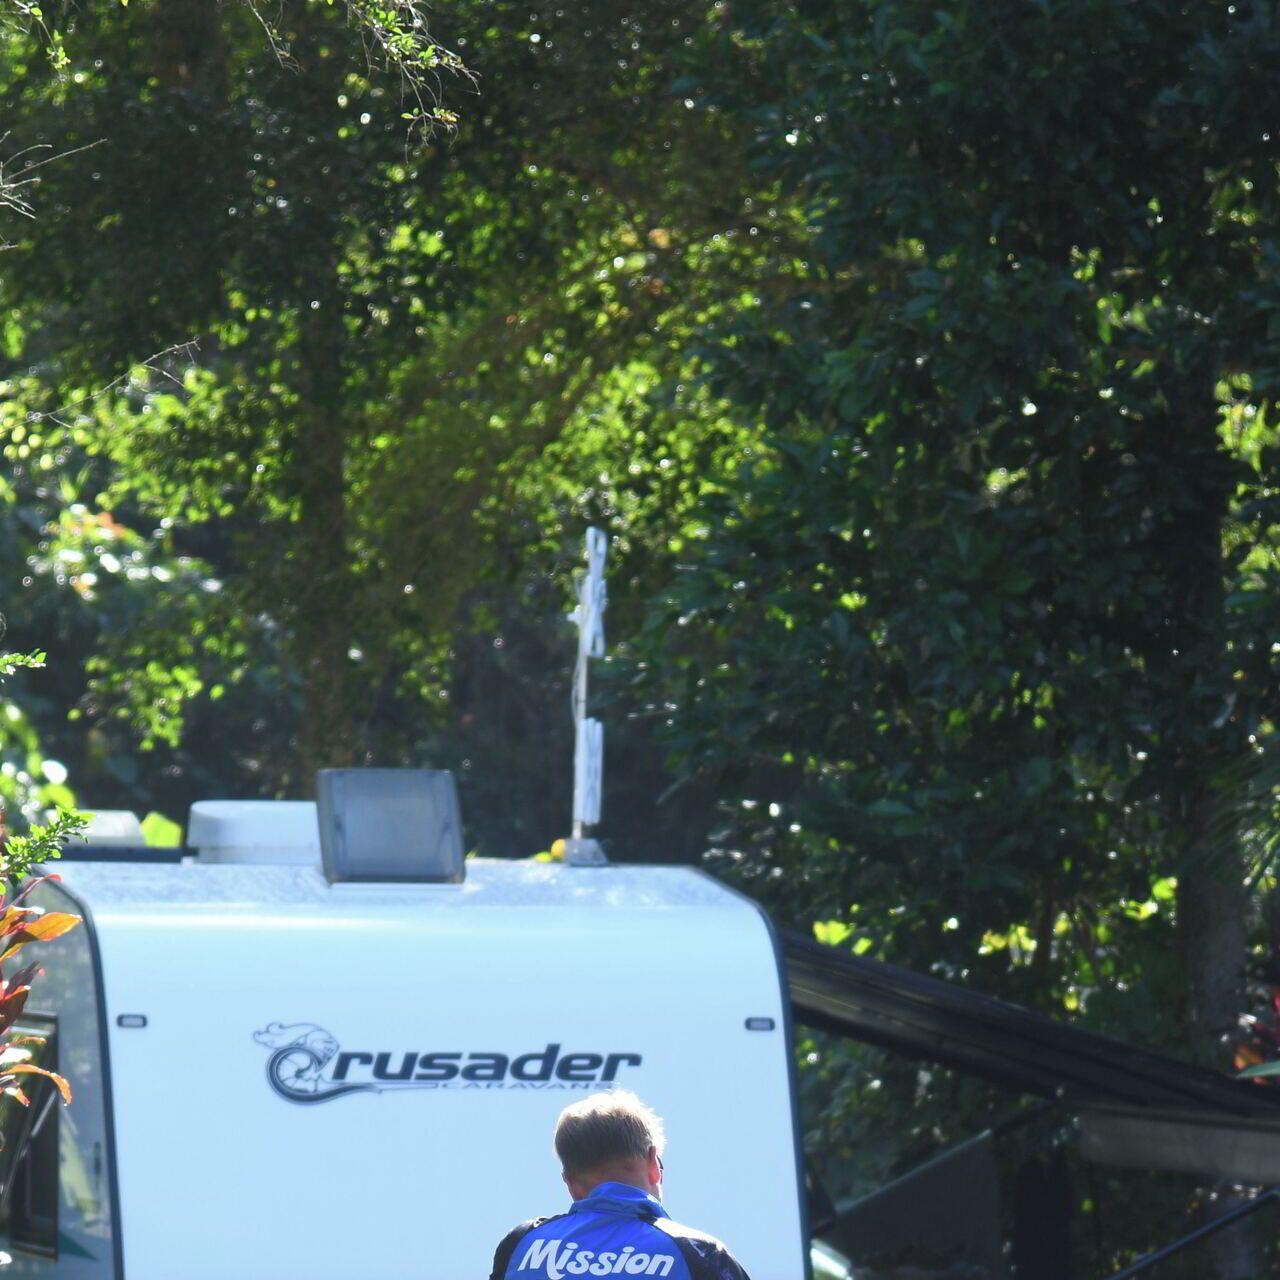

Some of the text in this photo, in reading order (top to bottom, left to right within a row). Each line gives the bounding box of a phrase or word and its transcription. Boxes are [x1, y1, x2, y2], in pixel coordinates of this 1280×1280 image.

[265, 1043, 642, 1106] Crusader
[441, 1081, 613, 1091] CARAVANS
[517, 1238, 675, 1280] Mission
